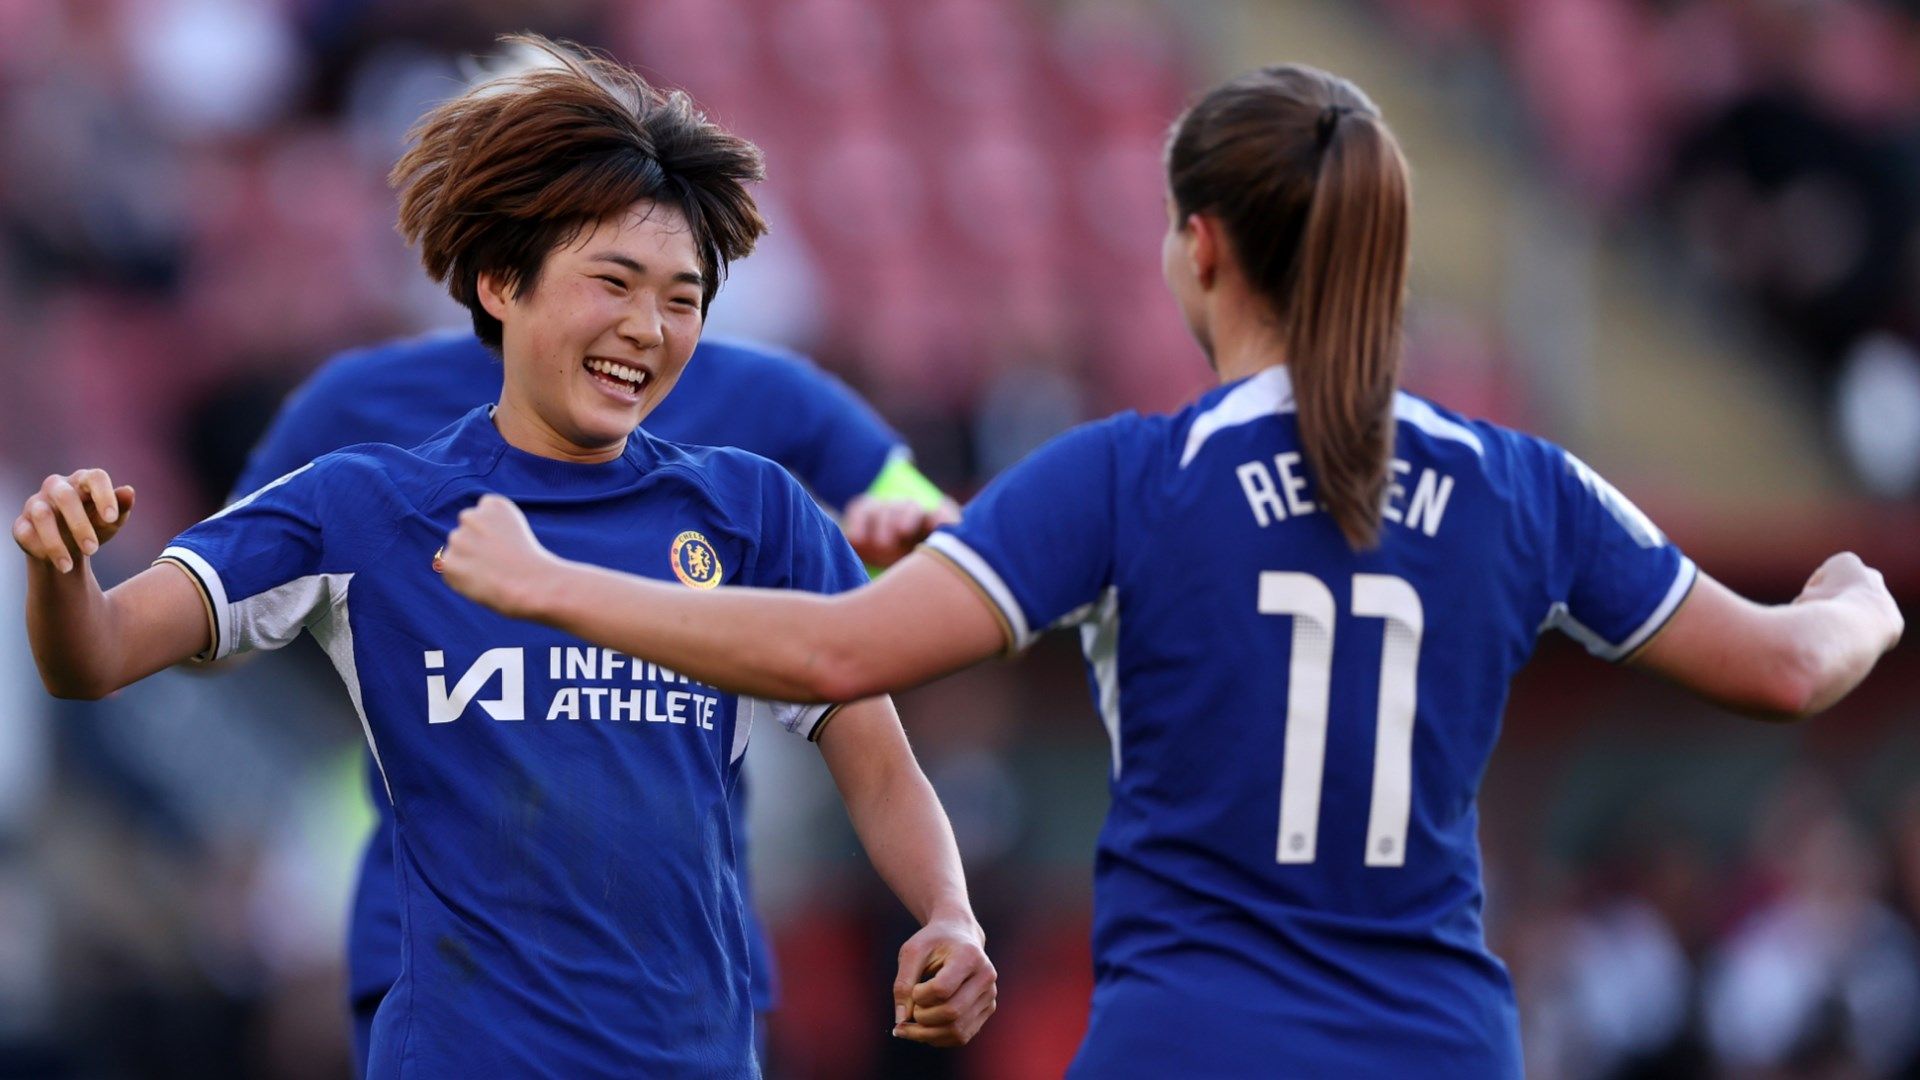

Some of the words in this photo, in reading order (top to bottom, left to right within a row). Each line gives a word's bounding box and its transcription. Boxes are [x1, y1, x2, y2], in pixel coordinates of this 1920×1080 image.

[1236, 452, 1455, 537] REEN
[550, 647, 718, 690] INFIN
[546, 688, 718, 730] ATHLETE
[1257, 570, 1423, 866] 11
